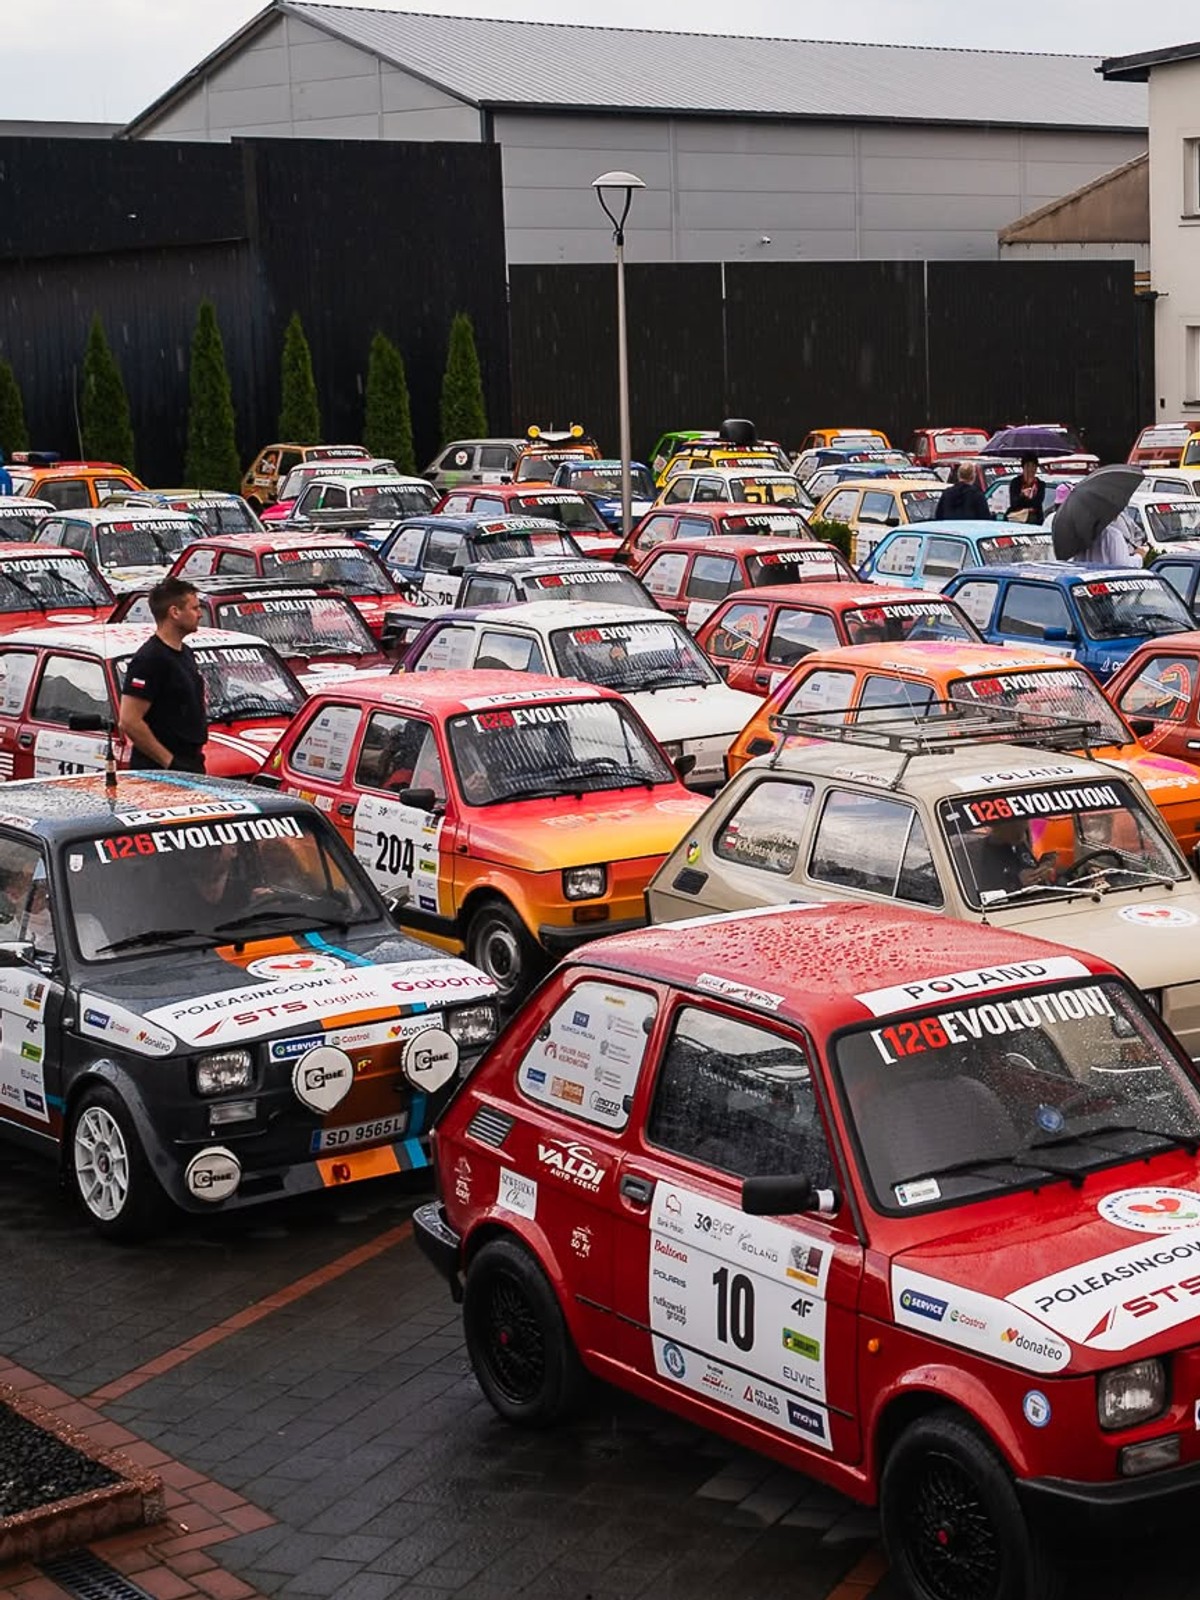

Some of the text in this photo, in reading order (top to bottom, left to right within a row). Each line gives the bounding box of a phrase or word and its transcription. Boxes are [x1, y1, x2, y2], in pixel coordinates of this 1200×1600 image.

[982, 765, 1073, 785] POLAND
[125, 801, 248, 824] POLAND
[963, 786, 1121, 828] [126EVOLUTION]
[95, 816, 303, 864] [126EVOLUTION]
[376, 831, 415, 879] 204
[902, 962, 1048, 1000] POLAND
[233, 1000, 309, 1026] STS
[870, 986, 1117, 1065] [126EVOLUTION]
[325, 1116, 403, 1147] SD 9565L
[537, 1143, 607, 1185] VALDI
[653, 1238, 688, 1264] Baltona
[740, 1243, 779, 1264] SOLAND
[653, 1268, 687, 1289] POLARIS
[652, 1295, 687, 1318] rutkowski
[712, 1266, 756, 1353] 10
[790, 1297, 815, 1319] 4F
[911, 1297, 944, 1316] SERVICE
[958, 1312, 988, 1331] Castrol
[1015, 1333, 1063, 1361] donateo
